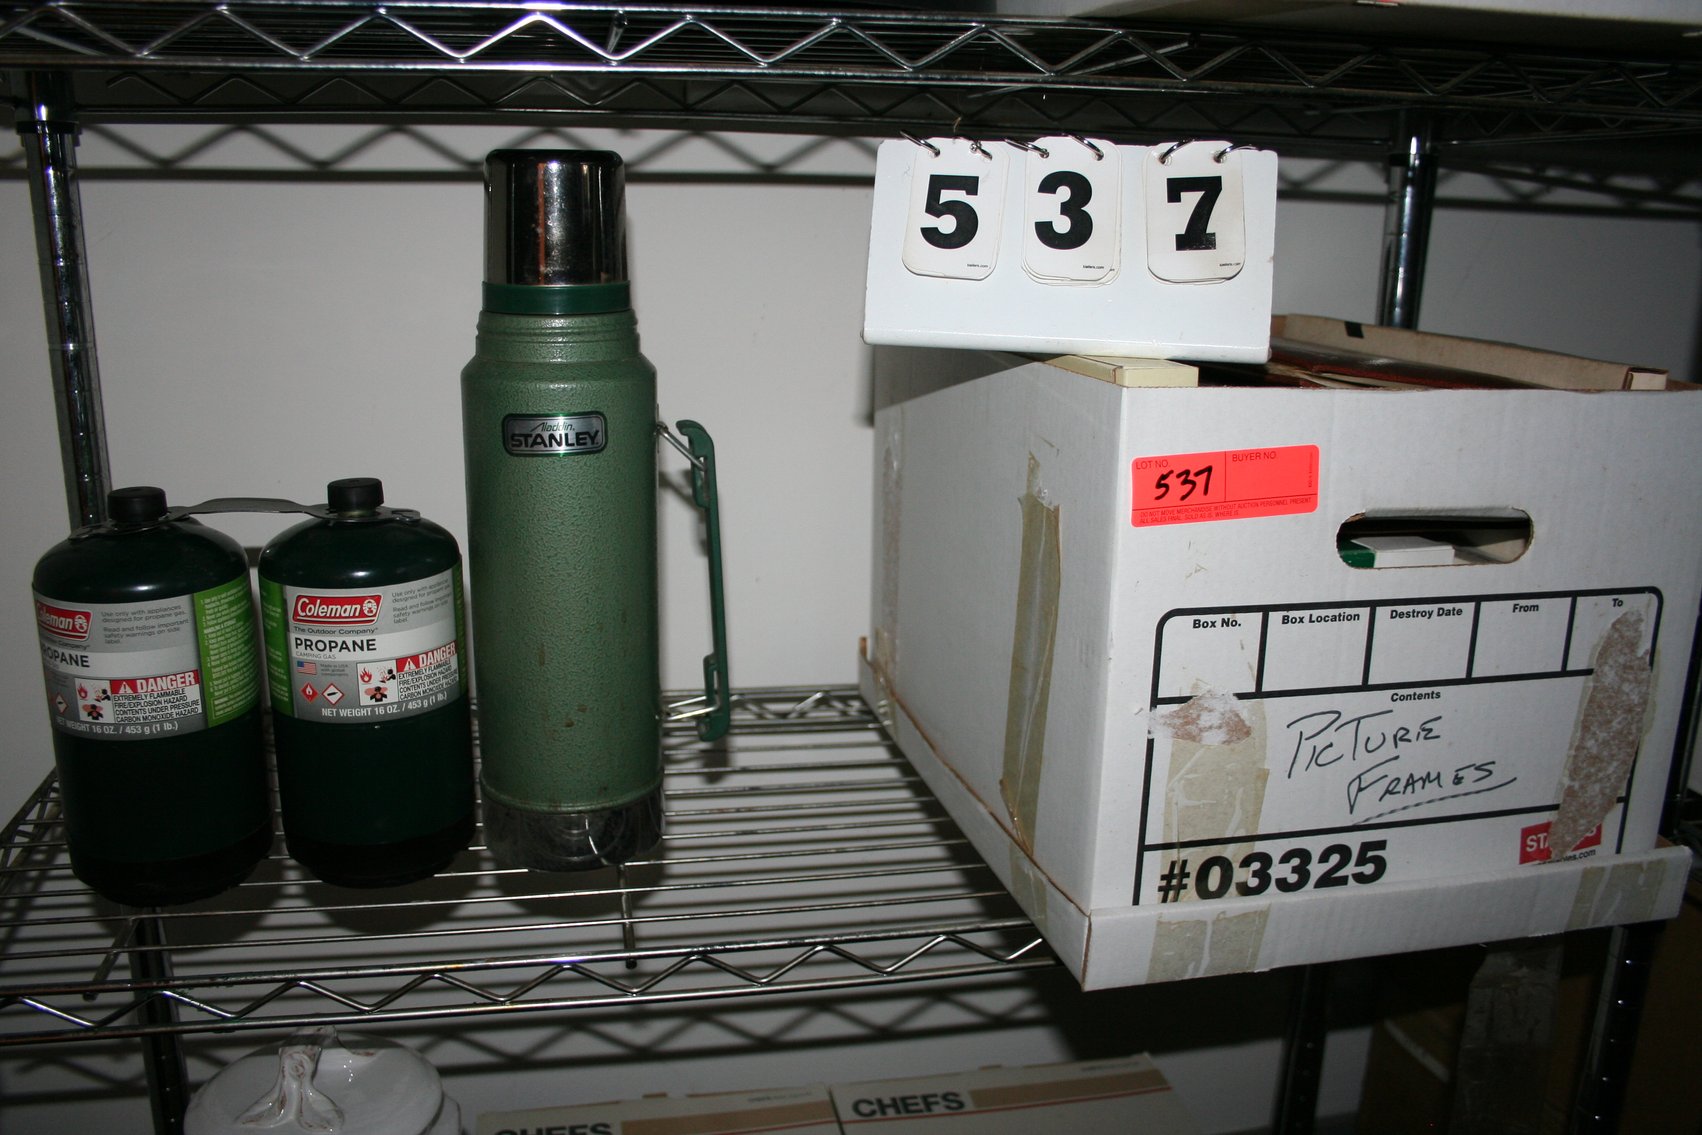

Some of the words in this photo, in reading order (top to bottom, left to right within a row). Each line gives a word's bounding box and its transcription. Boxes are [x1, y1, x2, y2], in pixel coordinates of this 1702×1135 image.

[920, 173, 980, 250] 5
[1034, 171, 1094, 250] 3
[1166, 175, 1223, 251] 7
[511, 429, 599, 448] STANLEY
[1136, 460, 1154, 470] LOT
[1232, 452, 1262, 462] BUYER
[1154, 465, 1213, 501] 537
[37, 602, 74, 630] leman
[101, 610, 114, 618] Use
[115, 610, 130, 618] only
[147, 605, 182, 615] appliances
[297, 598, 361, 617] Coleman
[1192, 619, 1217, 629] Box
[1221, 617, 1242, 628] No.
[1281, 614, 1305, 625] Box
[1308, 612, 1360, 624] Location
[1390, 608, 1434, 620] Destroy
[1436, 606, 1463, 617] Date
[1512, 603, 1540, 613] From
[1611, 598, 1624, 608] To
[102, 616, 133, 624] designed
[145, 613, 173, 622] propane
[104, 632, 125, 640] safety
[126, 629, 156, 639] warnings
[294, 626, 307, 634] The
[308, 627, 337, 635] Outdoor
[295, 637, 377, 652] PROPANE
[42, 643, 90, 668] OPANE
[296, 651, 322, 659] CAMPING
[419, 641, 456, 668] DANGER
[137, 671, 196, 694] DANGER
[398, 668, 427, 680] EXTREMELY
[399, 682, 426, 693] CONTENTS
[427, 677, 440, 688] UNDER
[113, 693, 149, 702] EXTREMELY
[150, 688, 186, 700] FLAMMABLE
[114, 700, 162, 709] FIRE/EXPLOSION
[163, 695, 188, 704] HAZARD
[400, 691, 422, 700] CARBON
[1390, 690, 1442, 702] Contents
[115, 708, 147, 716] CONTENTS
[148, 705, 170, 714] UNDER
[170, 699, 200, 711] PRESSURE
[116, 715, 142, 723] CARBON
[142, 712, 175, 722] MONOXIDE
[175, 707, 199, 717] HAZARD
[322, 708, 337, 717] NET
[339, 707, 371, 717] WEIGHT
[375, 706, 385, 715] 16
[408, 700, 422, 710] 453
[91, 724, 101, 733] 16
[125, 724, 142, 734] 453
[144, 725, 150, 735] g
[1347, 755, 1497, 814] FRAMES
[1157, 840, 1388, 903] #03325
[852, 1091, 966, 1118] CHEFS
